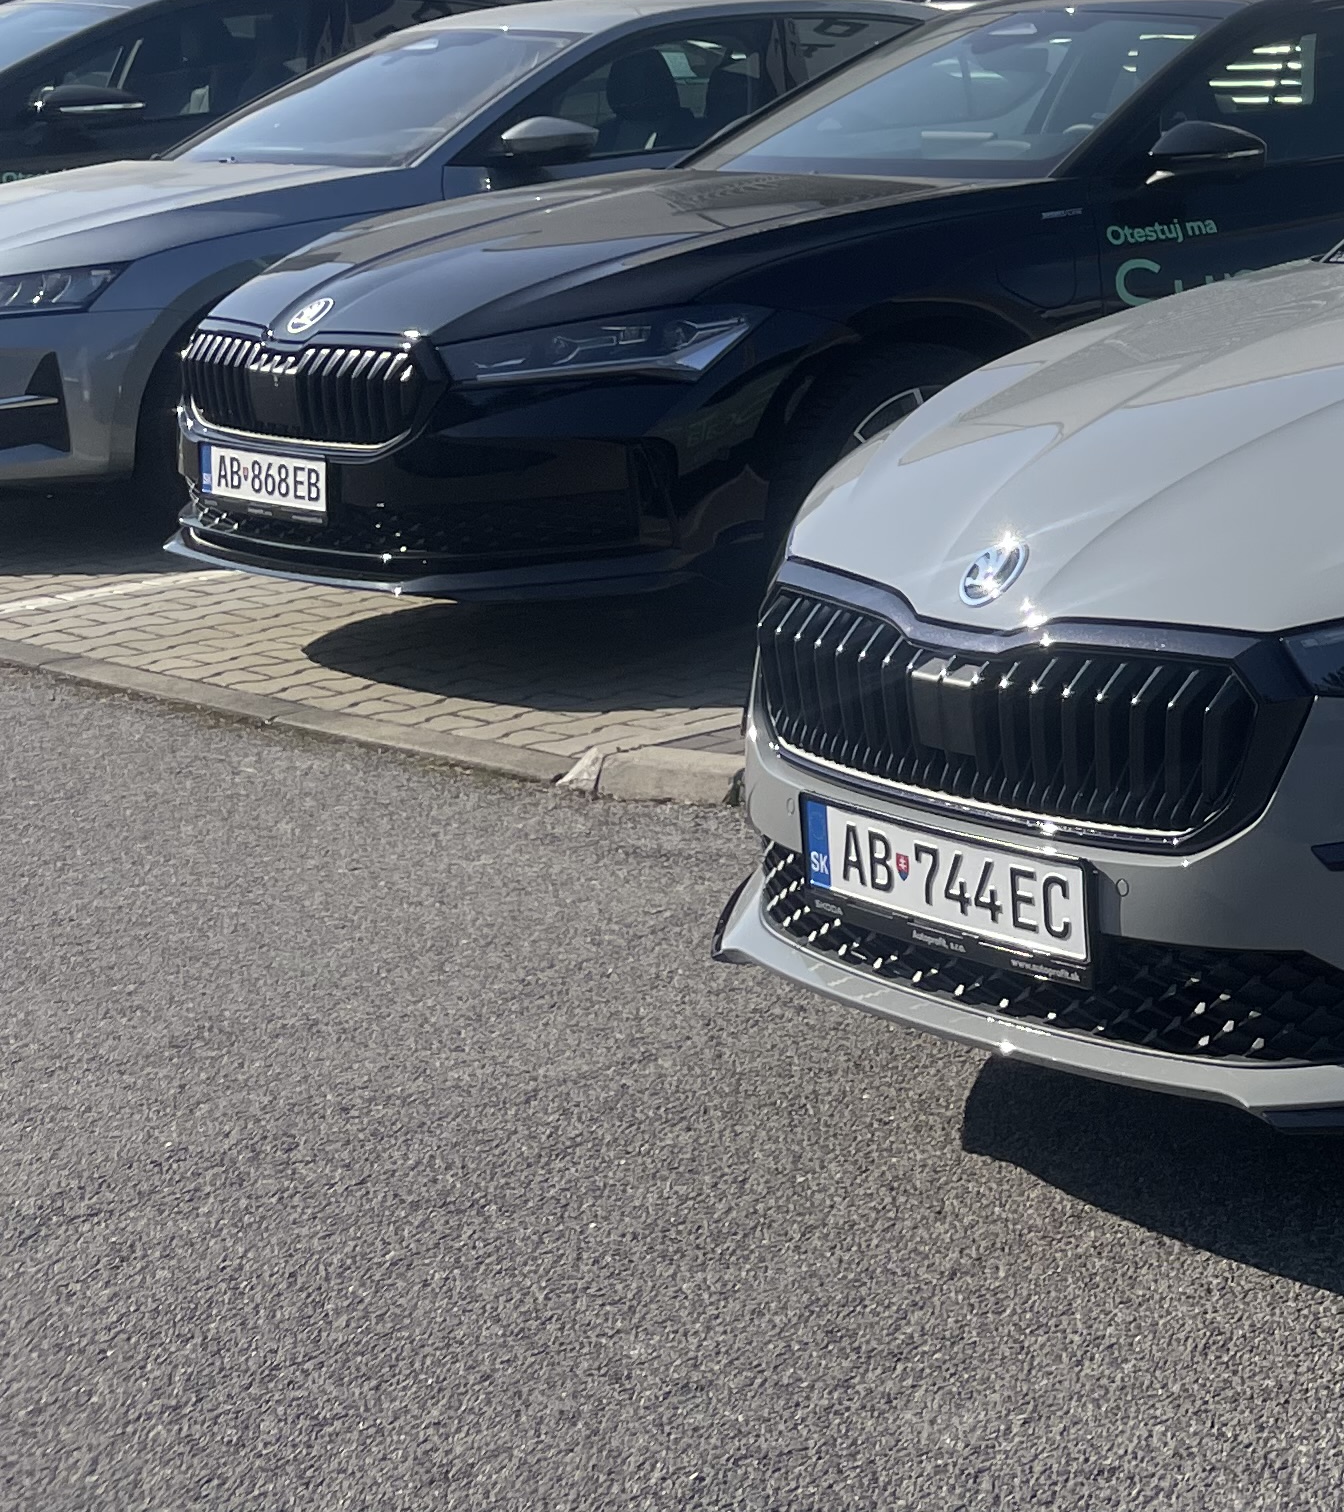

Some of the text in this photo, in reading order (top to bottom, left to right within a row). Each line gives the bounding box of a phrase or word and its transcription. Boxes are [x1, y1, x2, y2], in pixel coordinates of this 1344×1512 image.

[1106, 218, 1218, 246] Otestuj ma
[810, 851, 830, 875] SK
